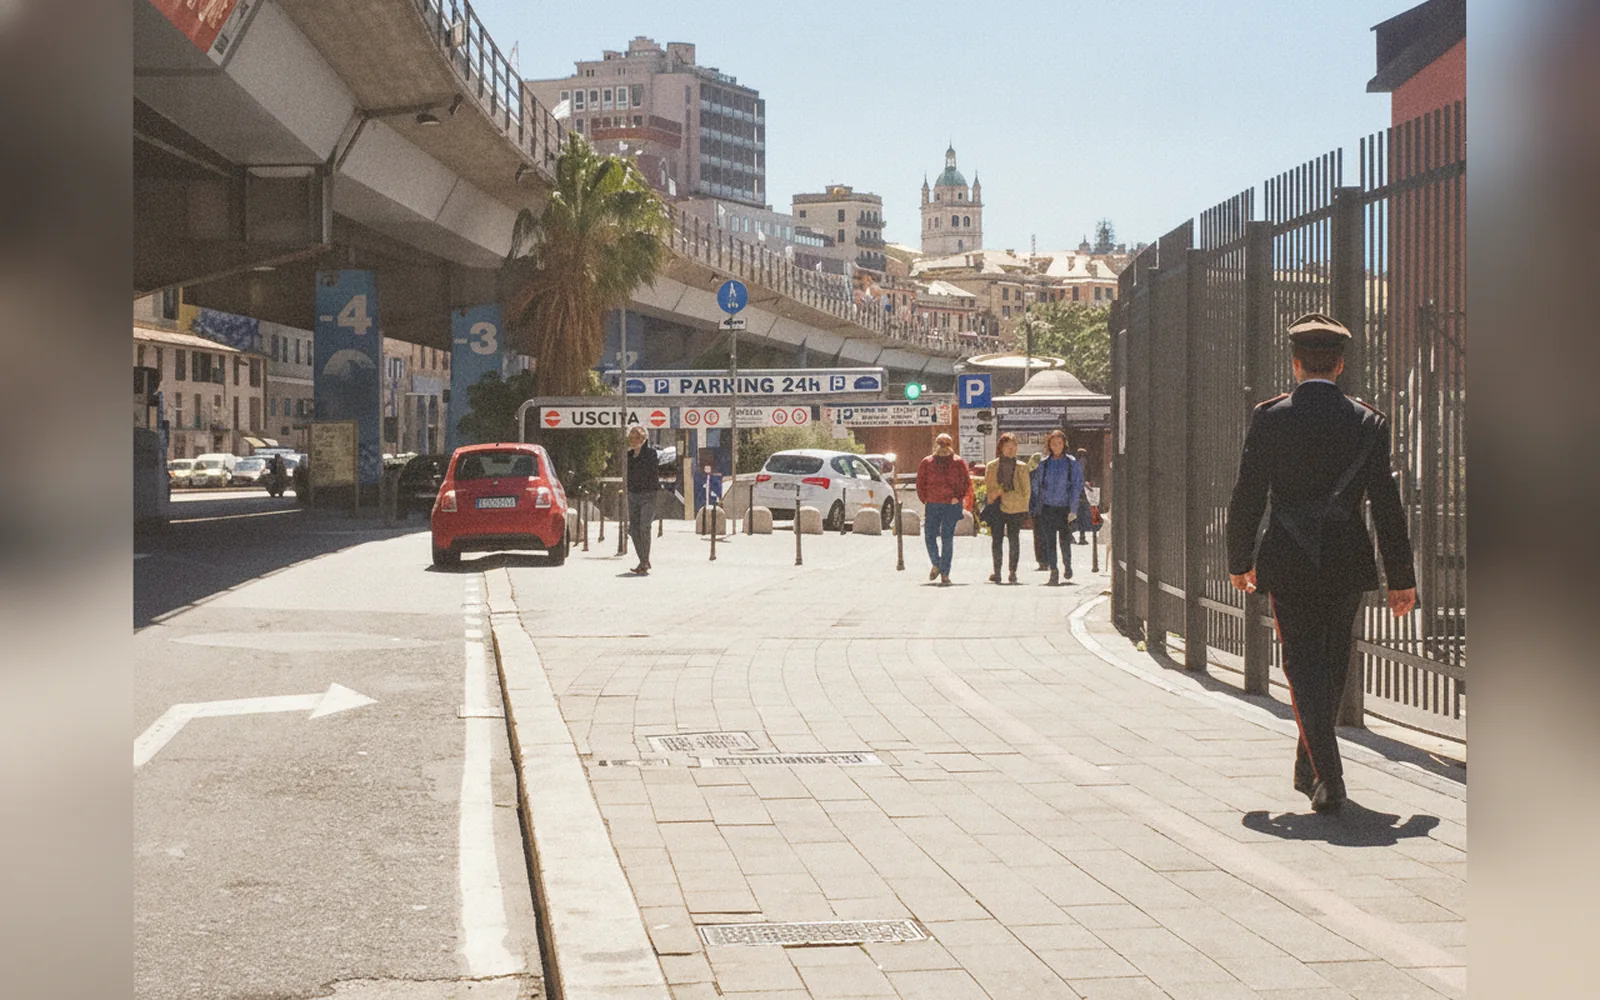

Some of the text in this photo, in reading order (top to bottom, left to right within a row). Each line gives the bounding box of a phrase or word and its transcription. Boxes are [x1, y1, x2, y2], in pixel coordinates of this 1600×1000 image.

[319, 294, 373, 335] -4
[454, 321, 498, 355] -3
[680, 377, 775, 394] PARKING
[781, 376, 821, 393] 24h
[966, 379, 985, 404] P
[571, 411, 640, 425] USCITA
